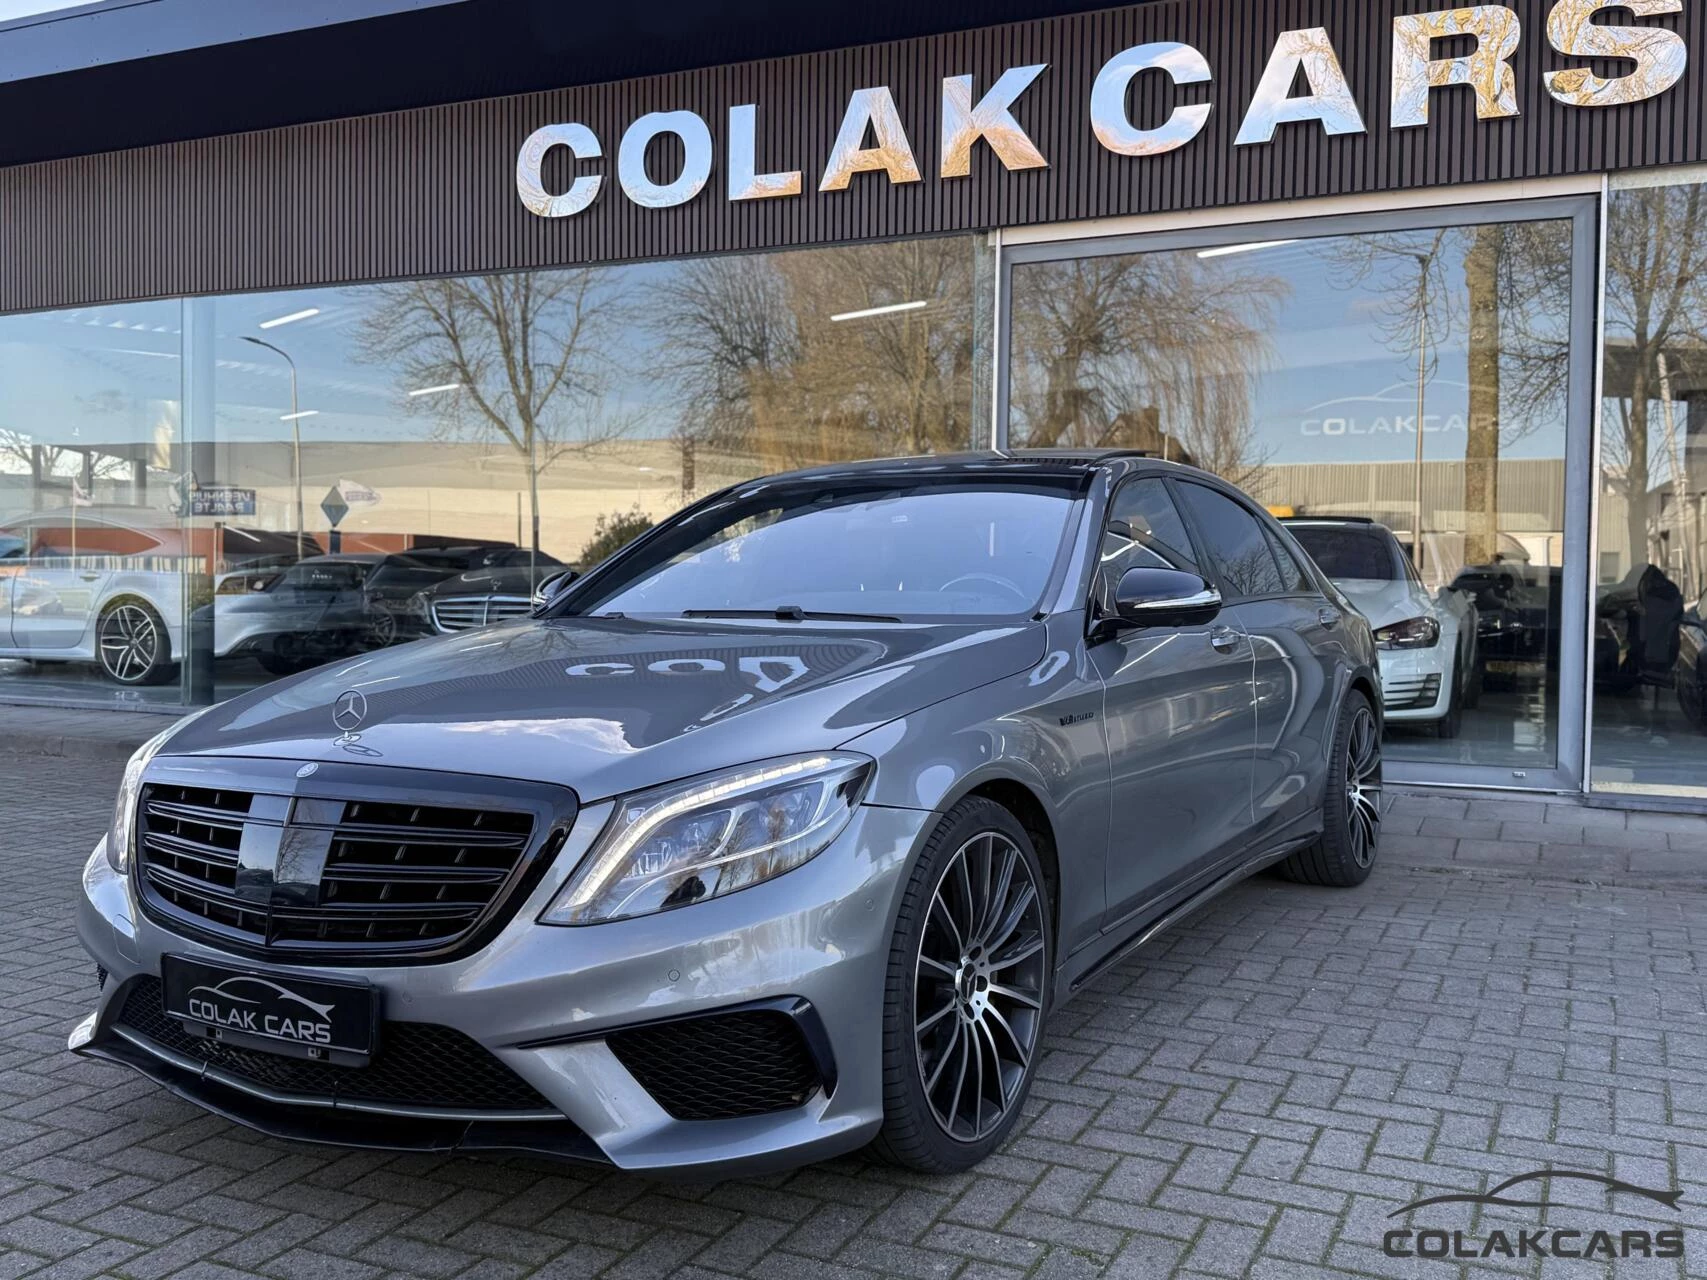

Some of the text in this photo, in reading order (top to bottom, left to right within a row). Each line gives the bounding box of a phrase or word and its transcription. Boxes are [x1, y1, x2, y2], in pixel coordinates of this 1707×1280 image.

[515, 0, 1686, 219] COLAK CARS
[1301, 415, 1511, 436] COLAKCAR
[189, 999, 331, 1043] COLAK CARS
